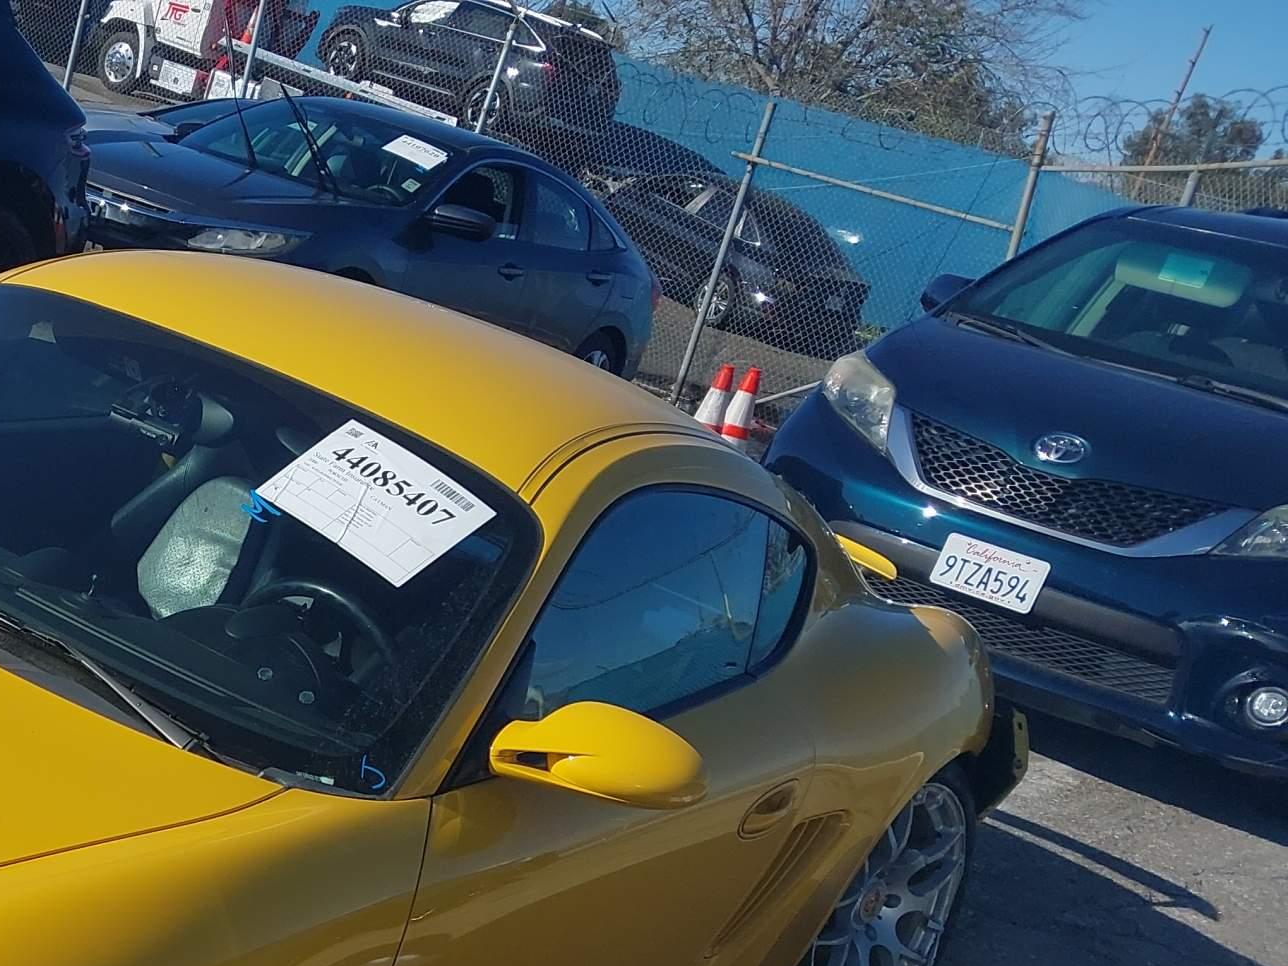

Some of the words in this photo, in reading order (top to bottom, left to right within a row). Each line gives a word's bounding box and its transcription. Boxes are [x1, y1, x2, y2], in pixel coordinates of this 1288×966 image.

[314, 451, 330, 463] State
[329, 461, 346, 474] Farm
[332, 447, 457, 525] 44085407
[966, 544, 1028, 572] California
[939, 555, 1028, 604] 9TZA594
